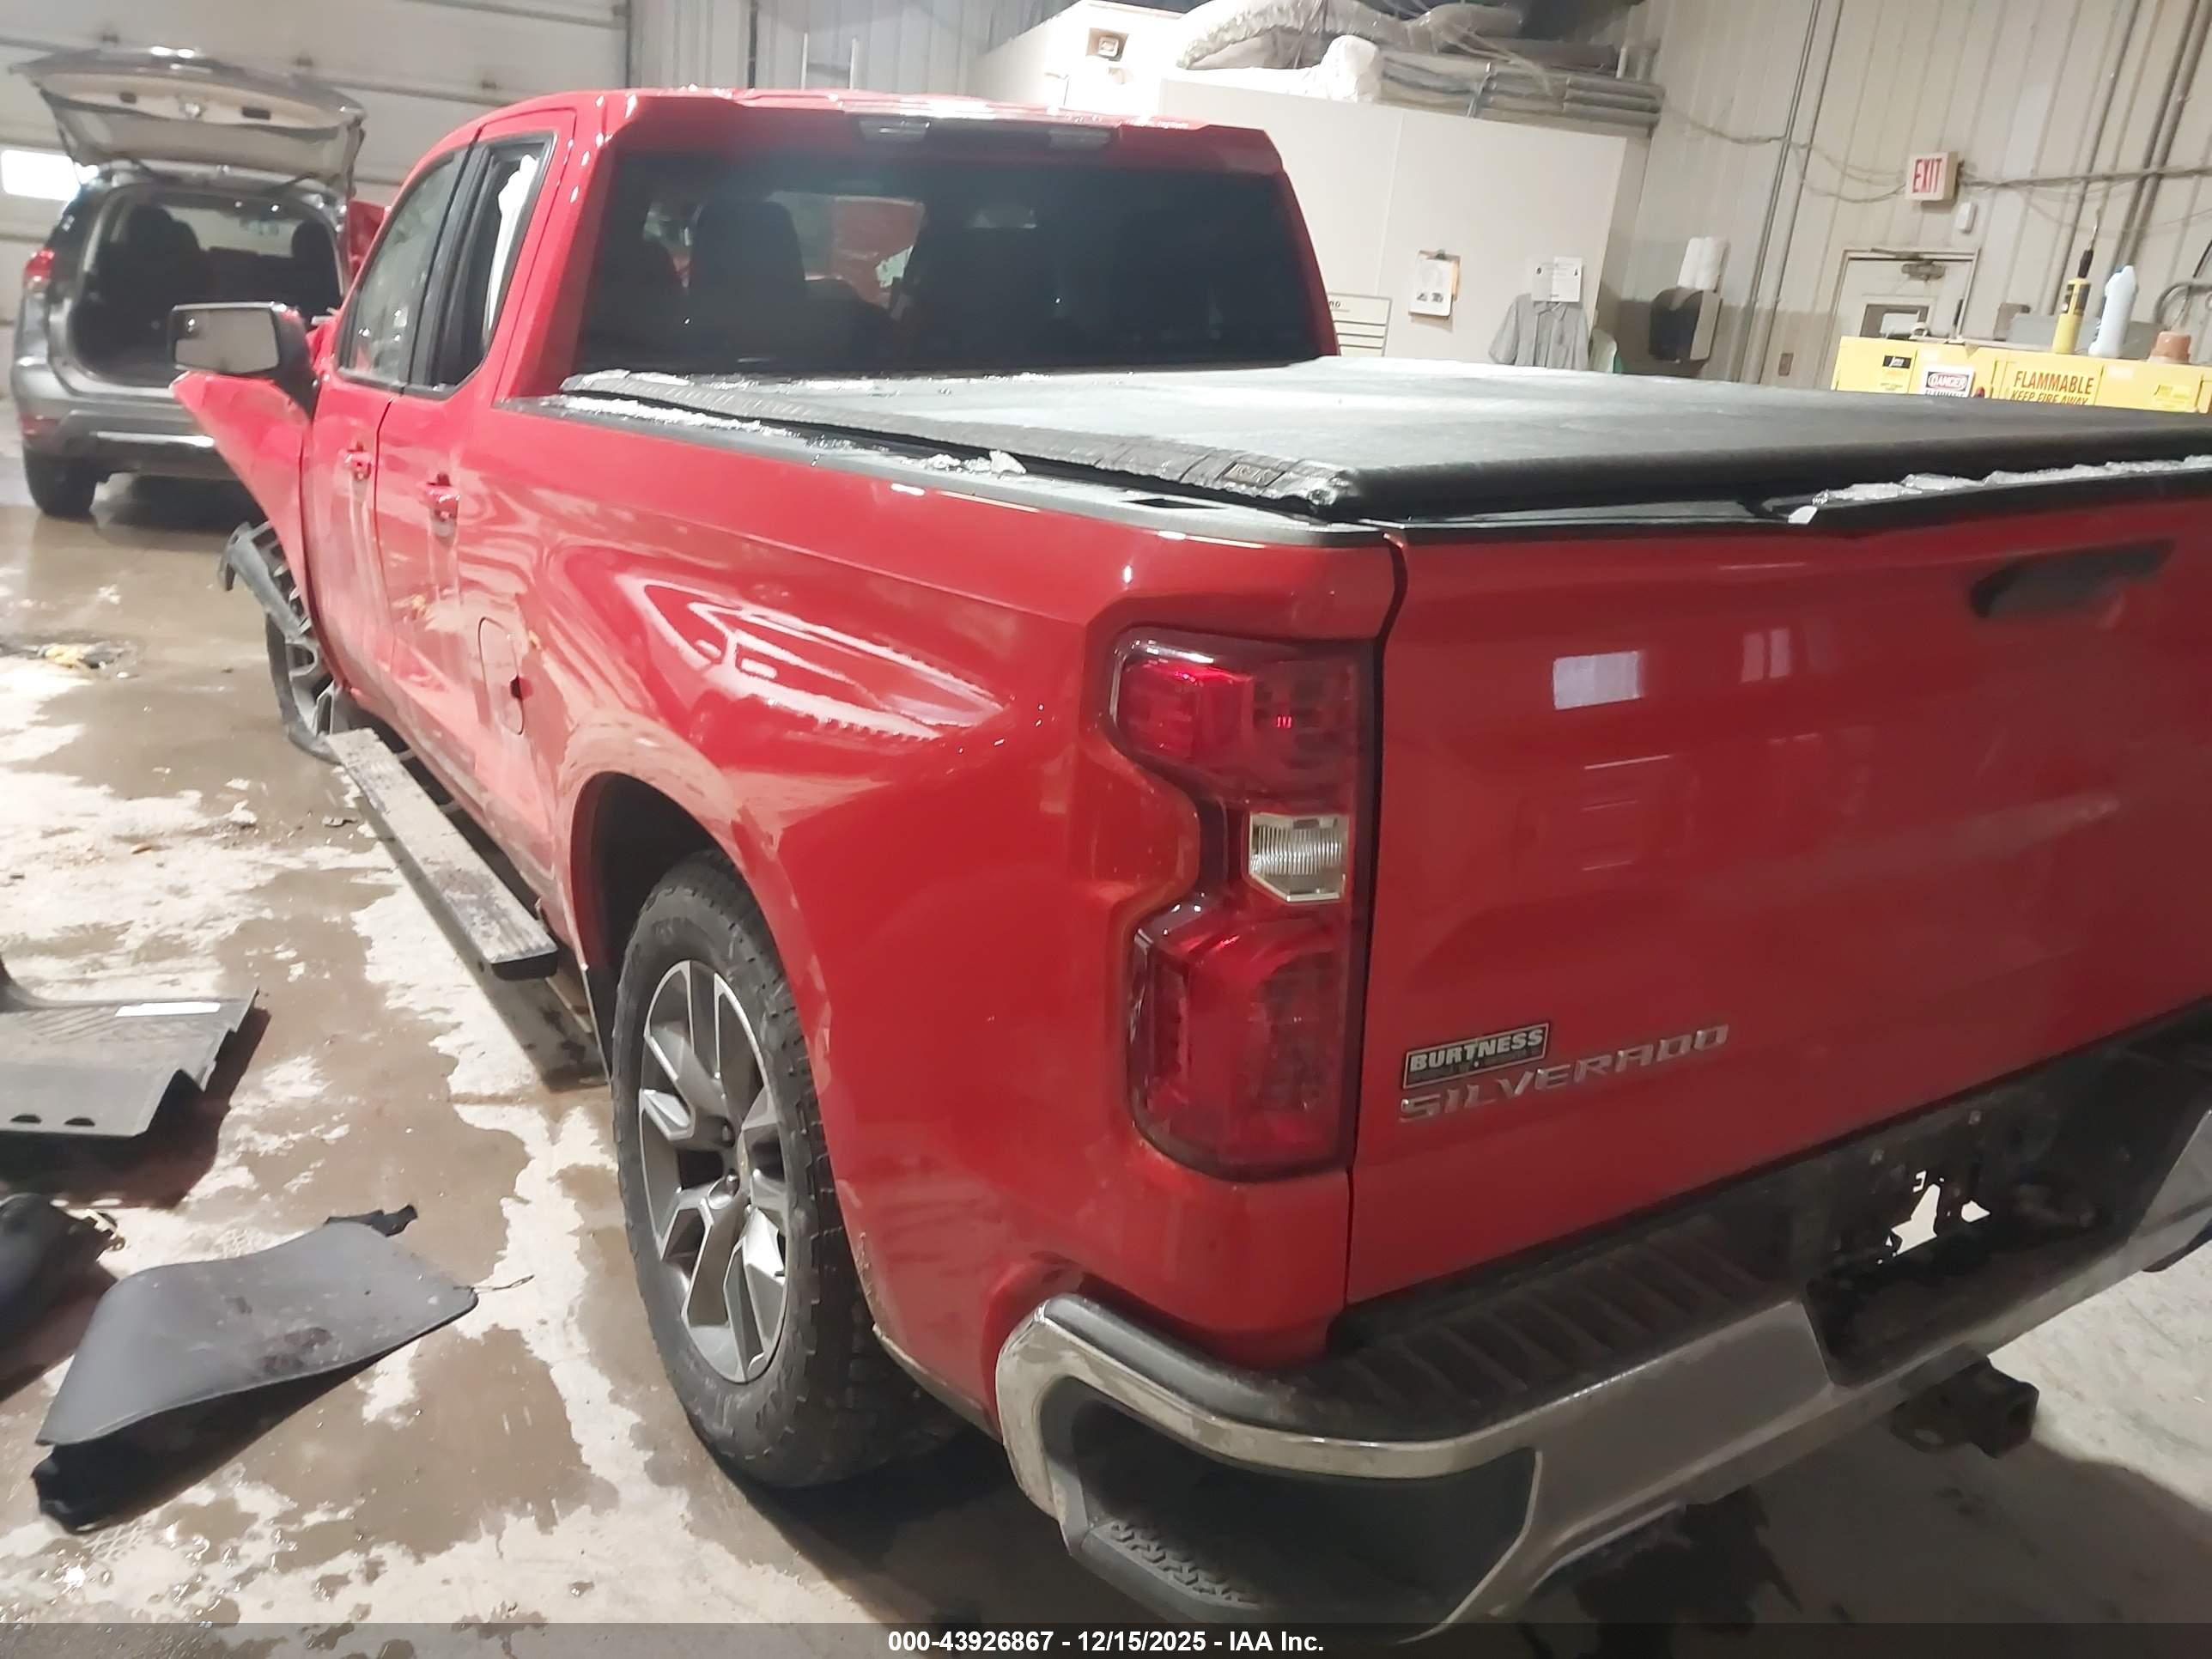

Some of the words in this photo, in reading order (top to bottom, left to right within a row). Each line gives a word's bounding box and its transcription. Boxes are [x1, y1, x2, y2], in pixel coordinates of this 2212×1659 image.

[1912, 158, 1942, 193] EXIT
[1930, 374, 1966, 389] DANGER
[2014, 370, 2094, 395] FLAMMABLE
[2010, 390, 2035, 402] KEEP
[2038, 392, 2059, 404] FIRE
[1409, 1029, 1544, 1073] BURTNESS
[1399, 1024, 1729, 1122] SILVERADO
